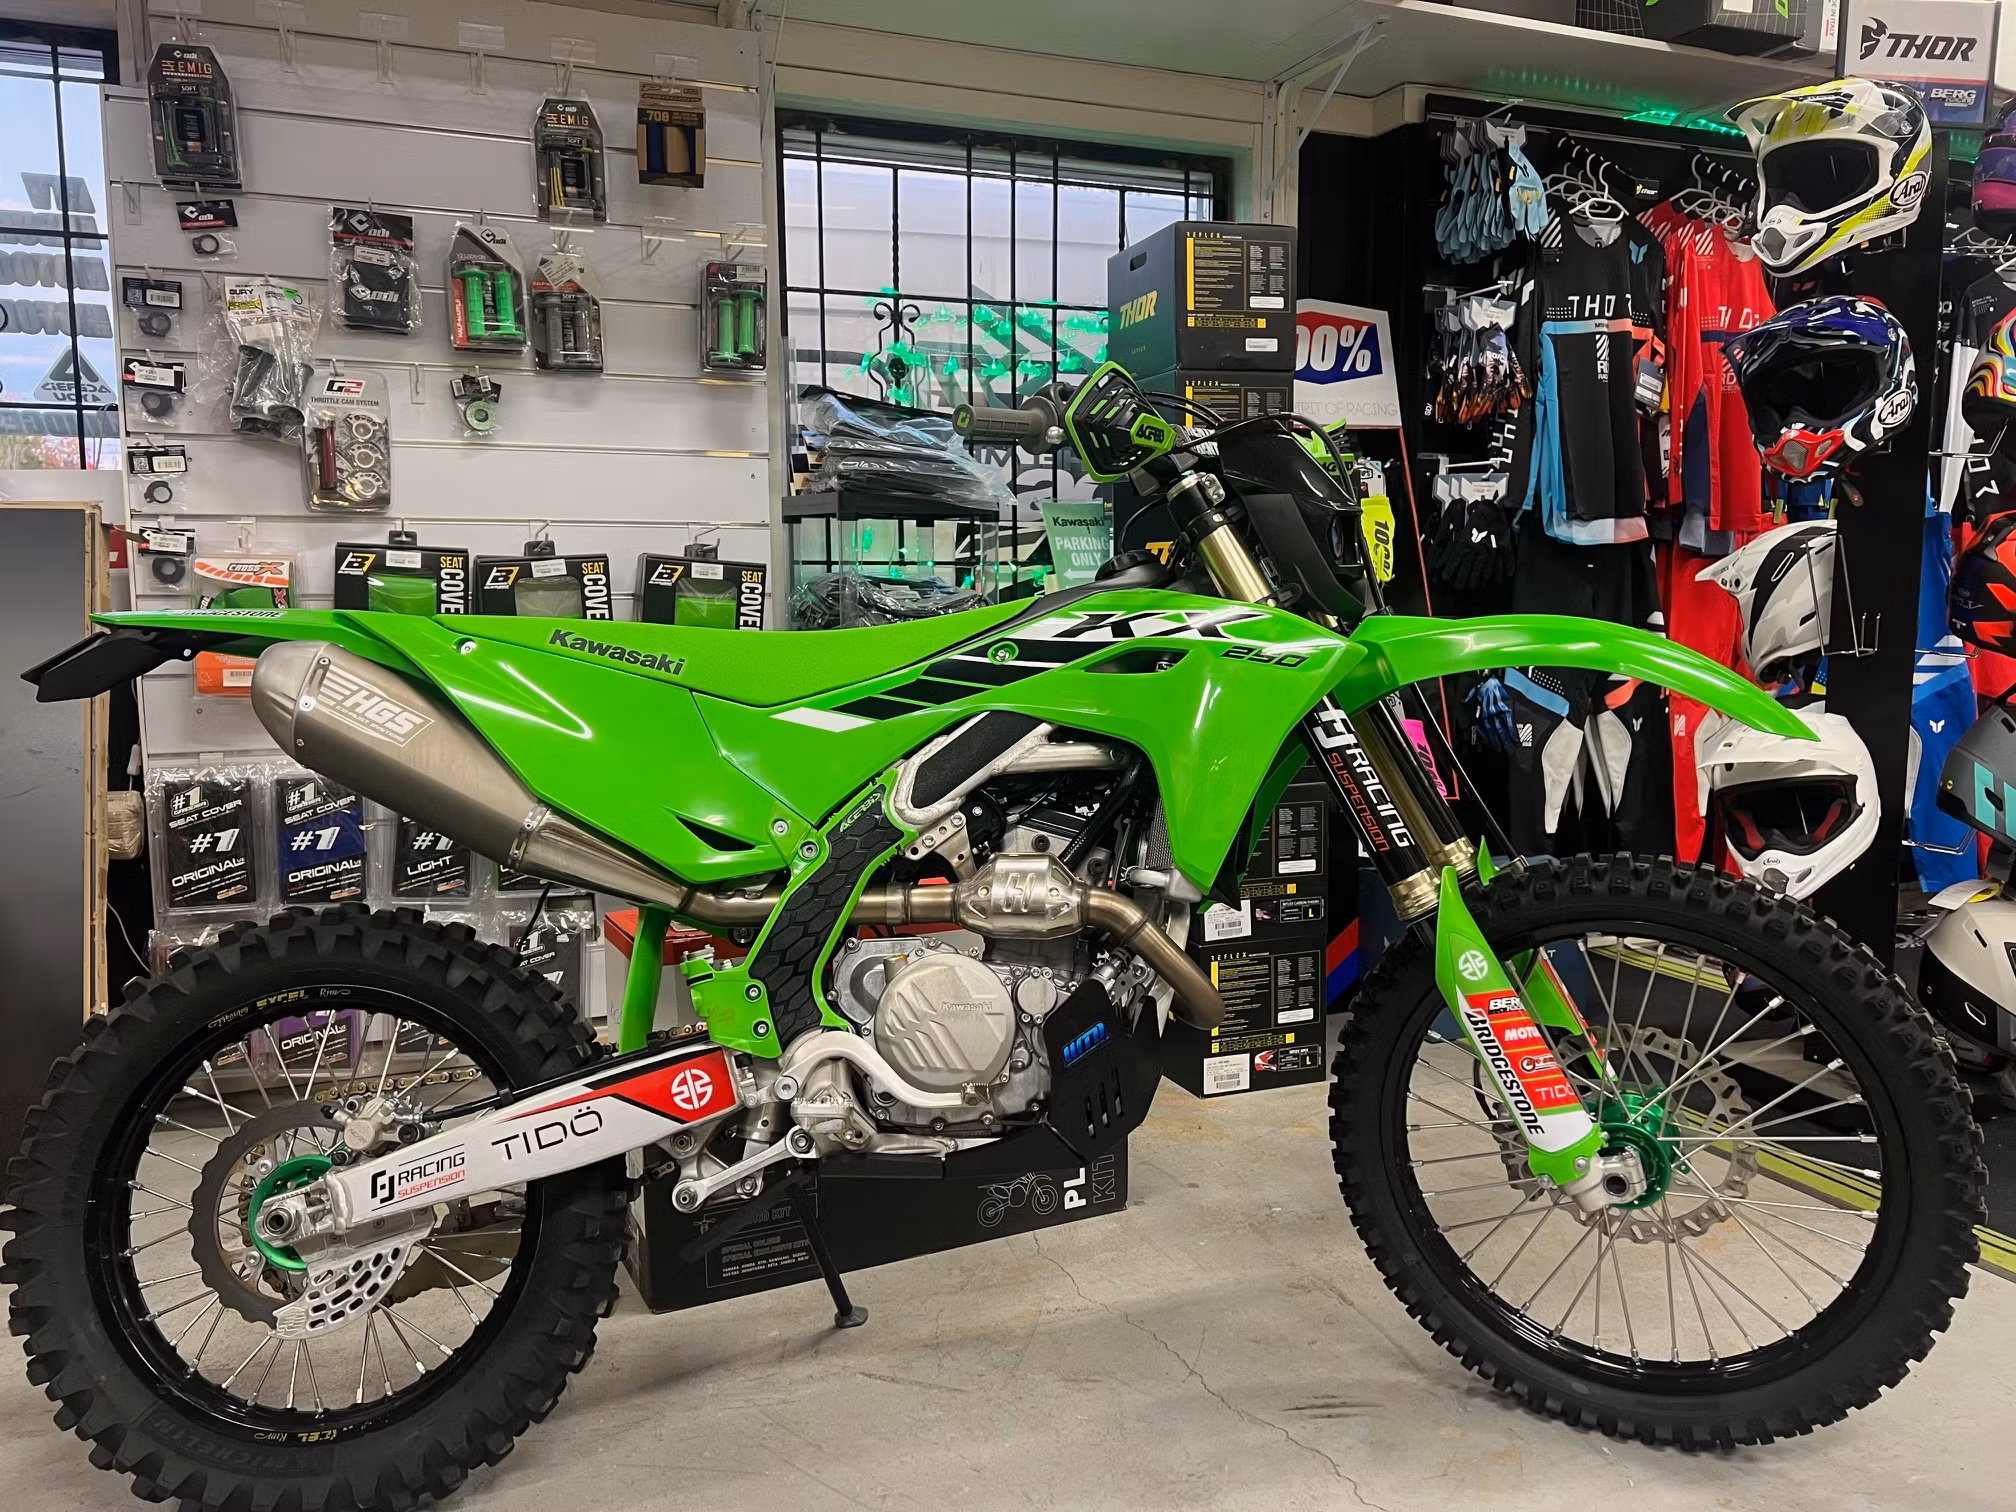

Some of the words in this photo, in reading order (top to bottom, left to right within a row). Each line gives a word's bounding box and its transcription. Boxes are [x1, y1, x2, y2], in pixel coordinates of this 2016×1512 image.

[1886, 33, 1978, 61] THOR
[178, 61, 212, 74] EMIG
[181, 84, 196, 92] SOFT
[1930, 88, 1976, 99] BERG
[560, 114, 588, 126] EMIG
[646, 110, 670, 122] 708
[368, 228, 390, 238] odi
[1119, 290, 1158, 330] THOR
[310, 396, 339, 404] THROTTLE
[1325, 402, 1342, 416] OF
[1346, 403, 1398, 417] RACING
[1052, 516, 1105, 527] Kawasaki
[1055, 536, 1108, 551] PARKING
[440, 556, 464, 569] SEAT
[582, 562, 605, 575] SEAT
[1071, 552, 1102, 567] ONLY
[741, 570, 763, 583] SEAT
[739, 582, 763, 631] COVE
[548, 629, 686, 676] Kawasaki
[1220, 644, 1313, 669] 250
[342, 689, 424, 735] HGS
[172, 786, 202, 811] #1
[287, 782, 316, 807] #1
[1326, 752, 1391, 852] SUSPENSION
[168, 813, 200, 829] SEAT
[201, 799, 243, 818] COVER
[284, 809, 315, 825] SEAT
[316, 795, 357, 814] COVER
[189, 828, 241, 854] #1
[290, 826, 341, 851] #1
[171, 858, 246, 888] ORIGINAL
[288, 859, 362, 883] ORIGINAL
[406, 855, 453, 876] LIGHT
[530, 951, 556, 965] COVER
[942, 1000, 993, 1012] Kawasaki
[281, 1025, 347, 1051] ORIGNAL
[1464, 1011, 1546, 1135] BRIDGESTONE
[491, 1106, 604, 1161] TIDÖ
[397, 1169, 466, 1200] SUSPENSION
[771, 1205, 792, 1219] KIT
